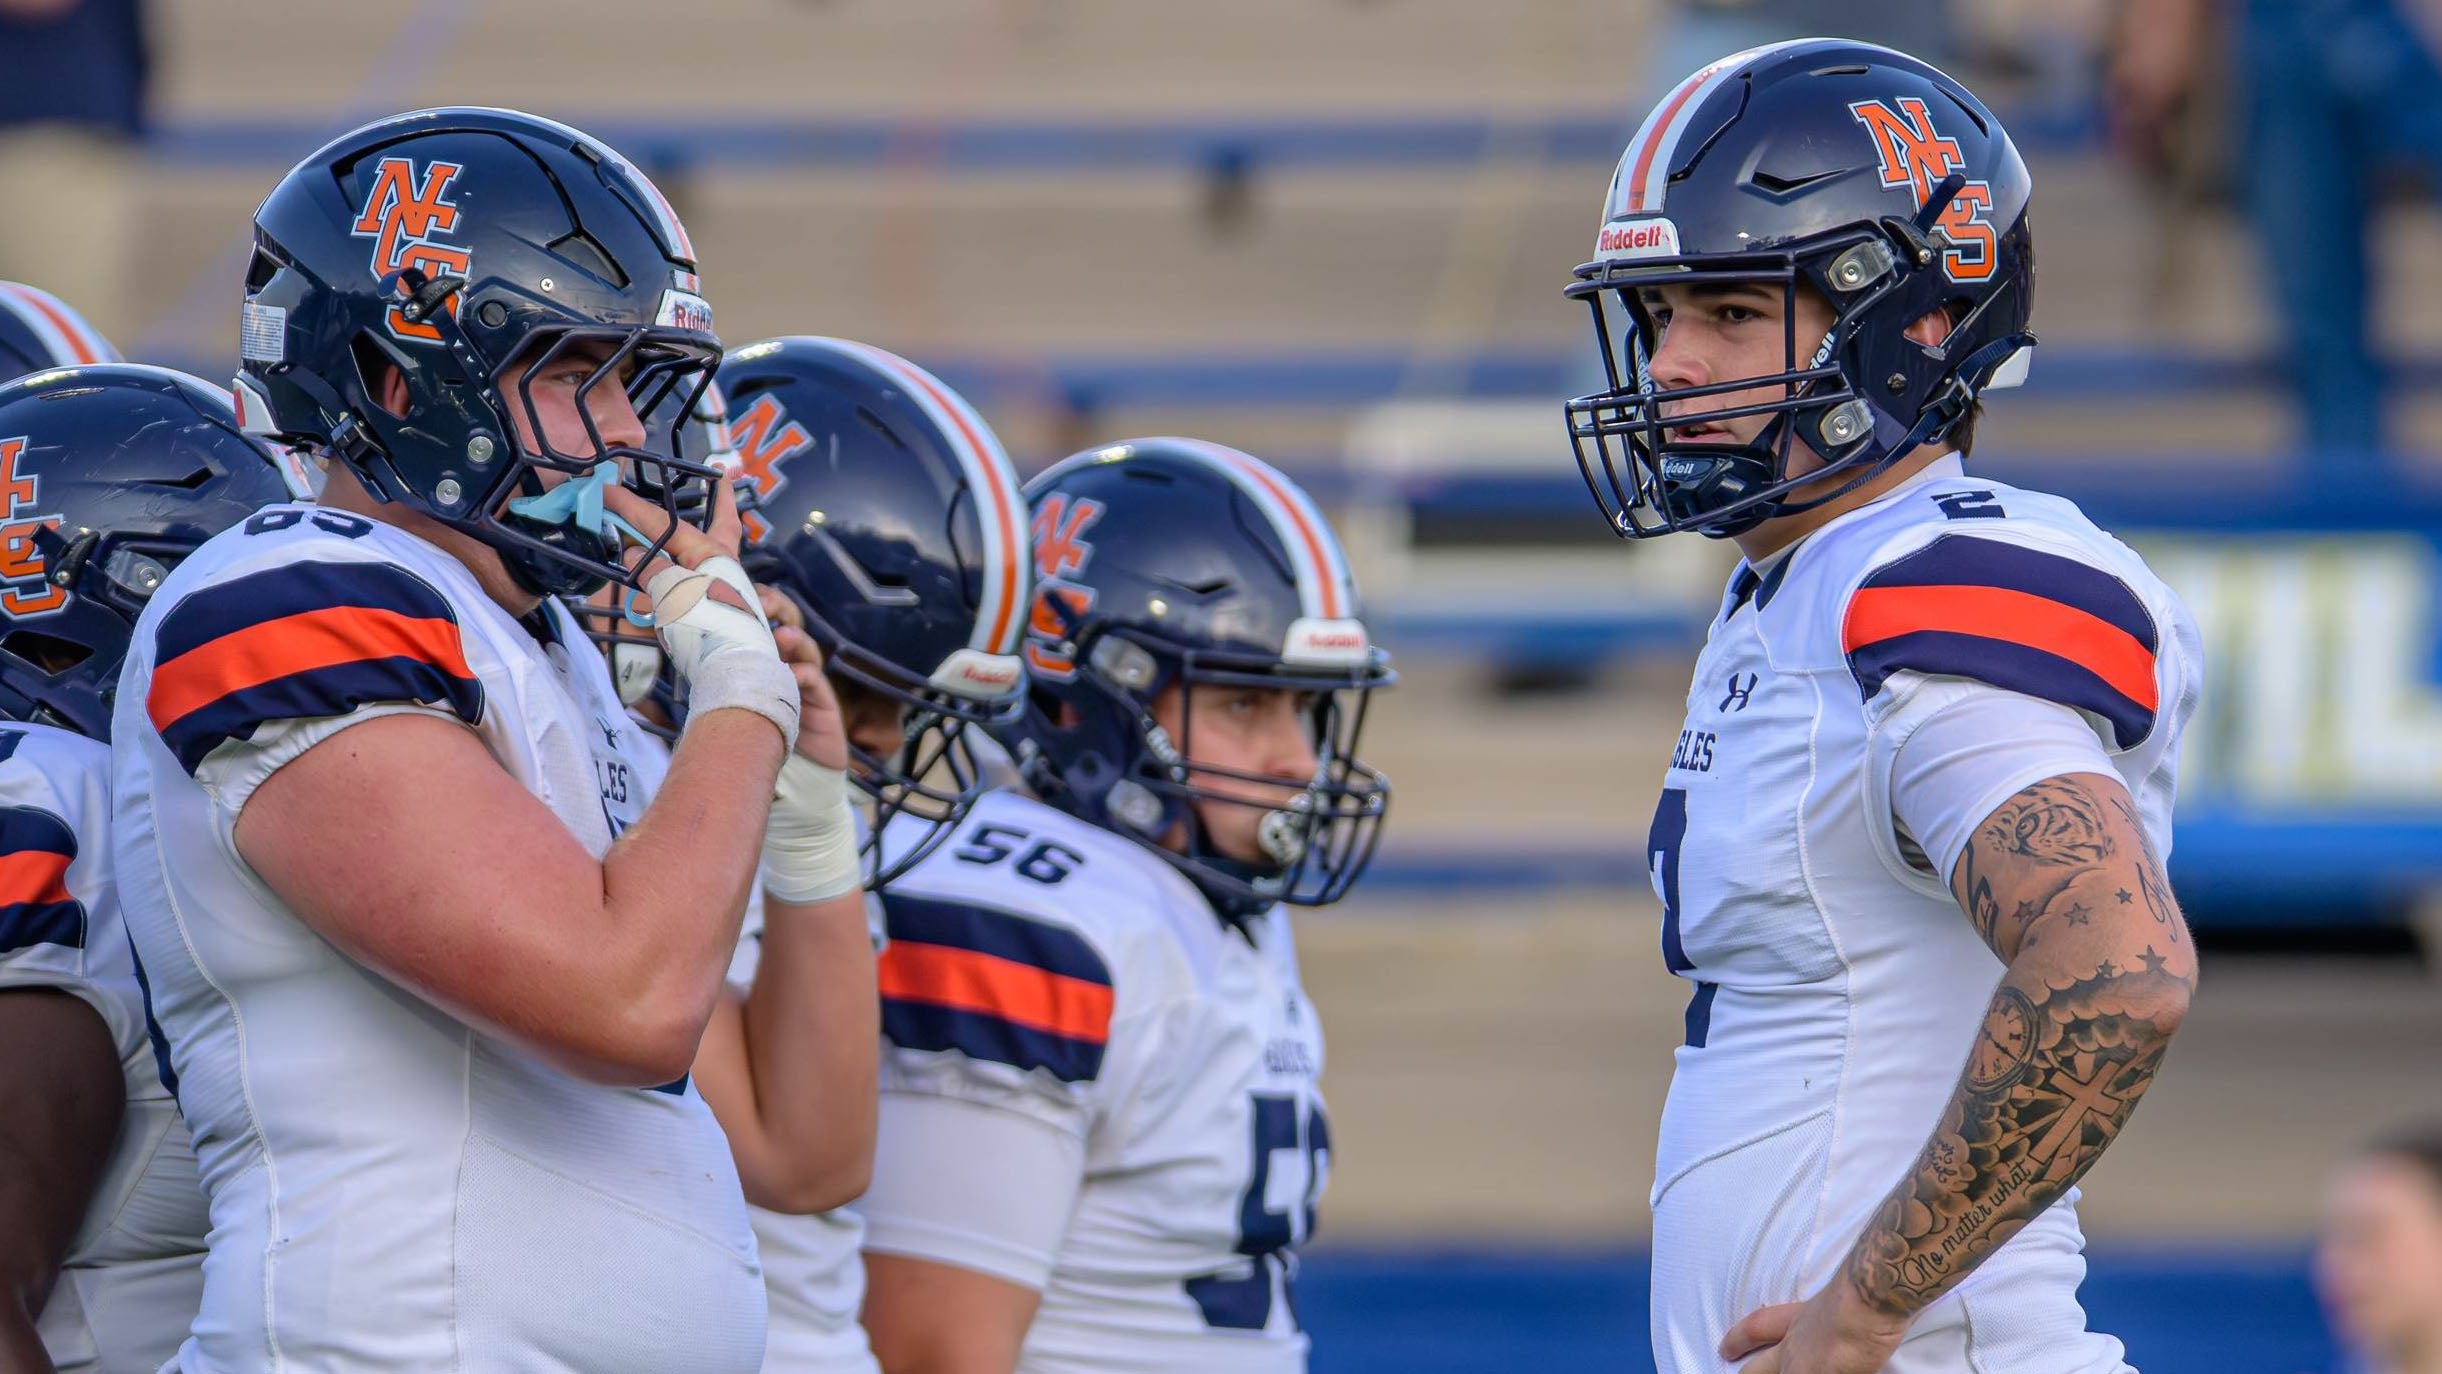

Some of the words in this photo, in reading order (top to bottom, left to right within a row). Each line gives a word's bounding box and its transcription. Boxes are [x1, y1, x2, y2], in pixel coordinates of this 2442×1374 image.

[1600, 225, 1662, 252] Riddell
[1930, 490, 2006, 520] 2
[954, 821, 1087, 886] 56
[1903, 1252, 1950, 1286] No
[1941, 1205, 1993, 1255] matter
[1988, 1159, 2033, 1207] what
